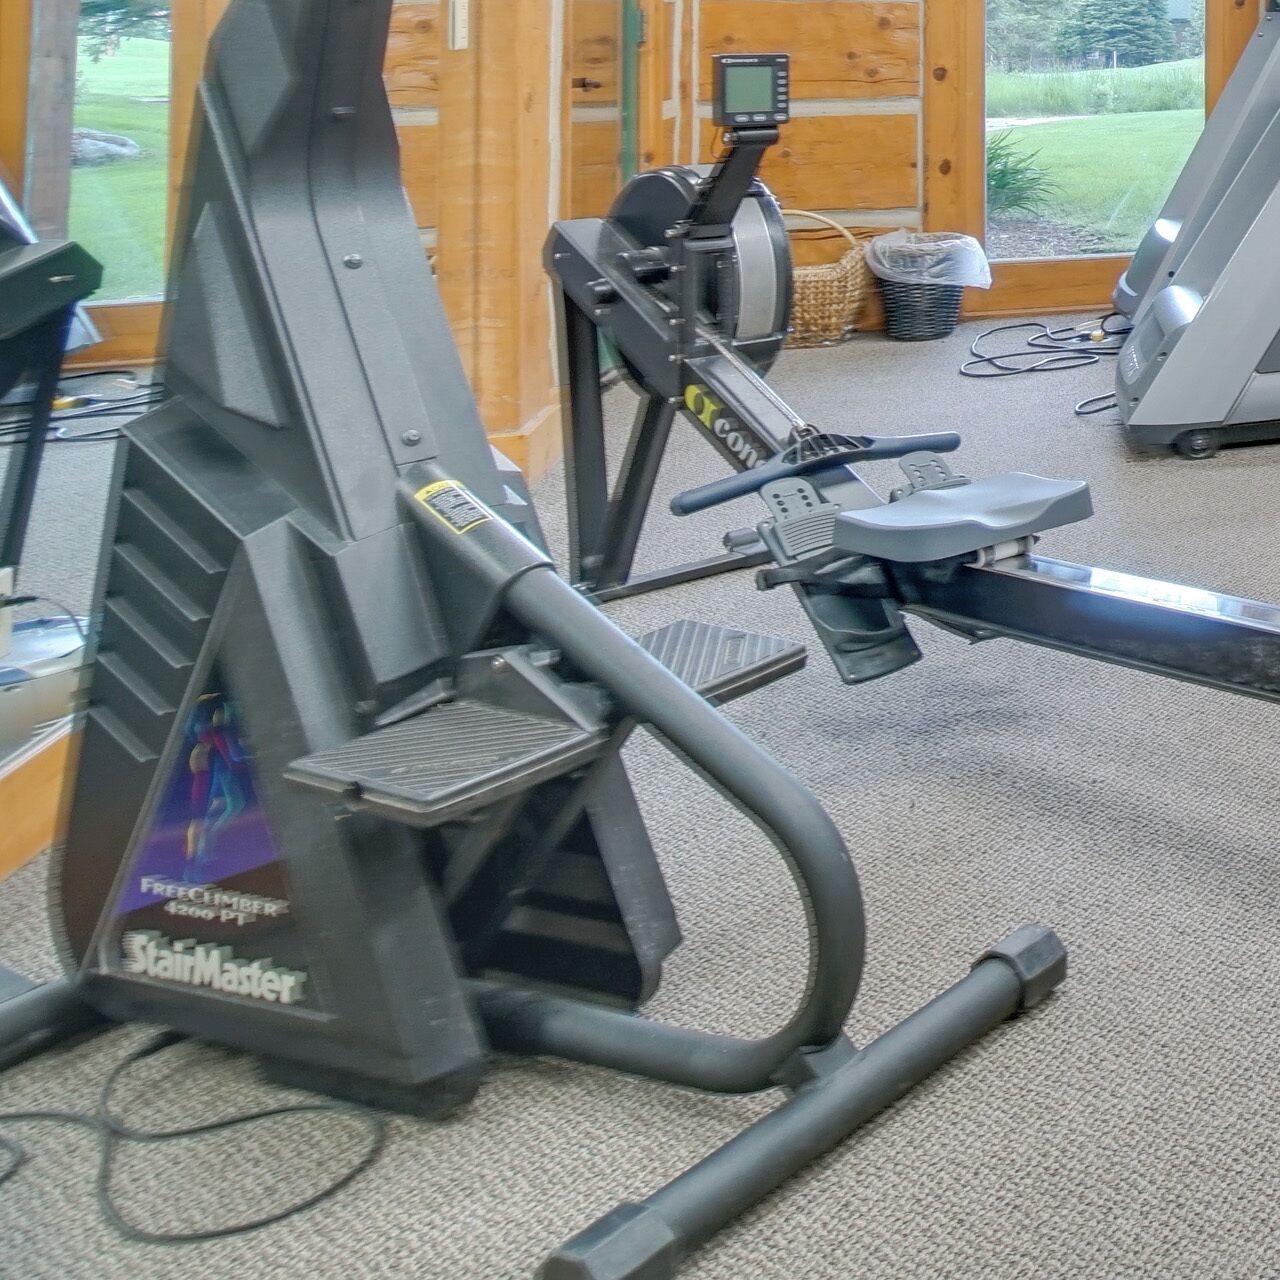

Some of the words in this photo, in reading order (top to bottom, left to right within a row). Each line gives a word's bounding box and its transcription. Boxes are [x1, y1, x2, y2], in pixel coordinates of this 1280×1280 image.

[163, 900, 216, 921] 4200
[220, 911, 256, 927] PT
[122, 931, 301, 1004] StairMaster
